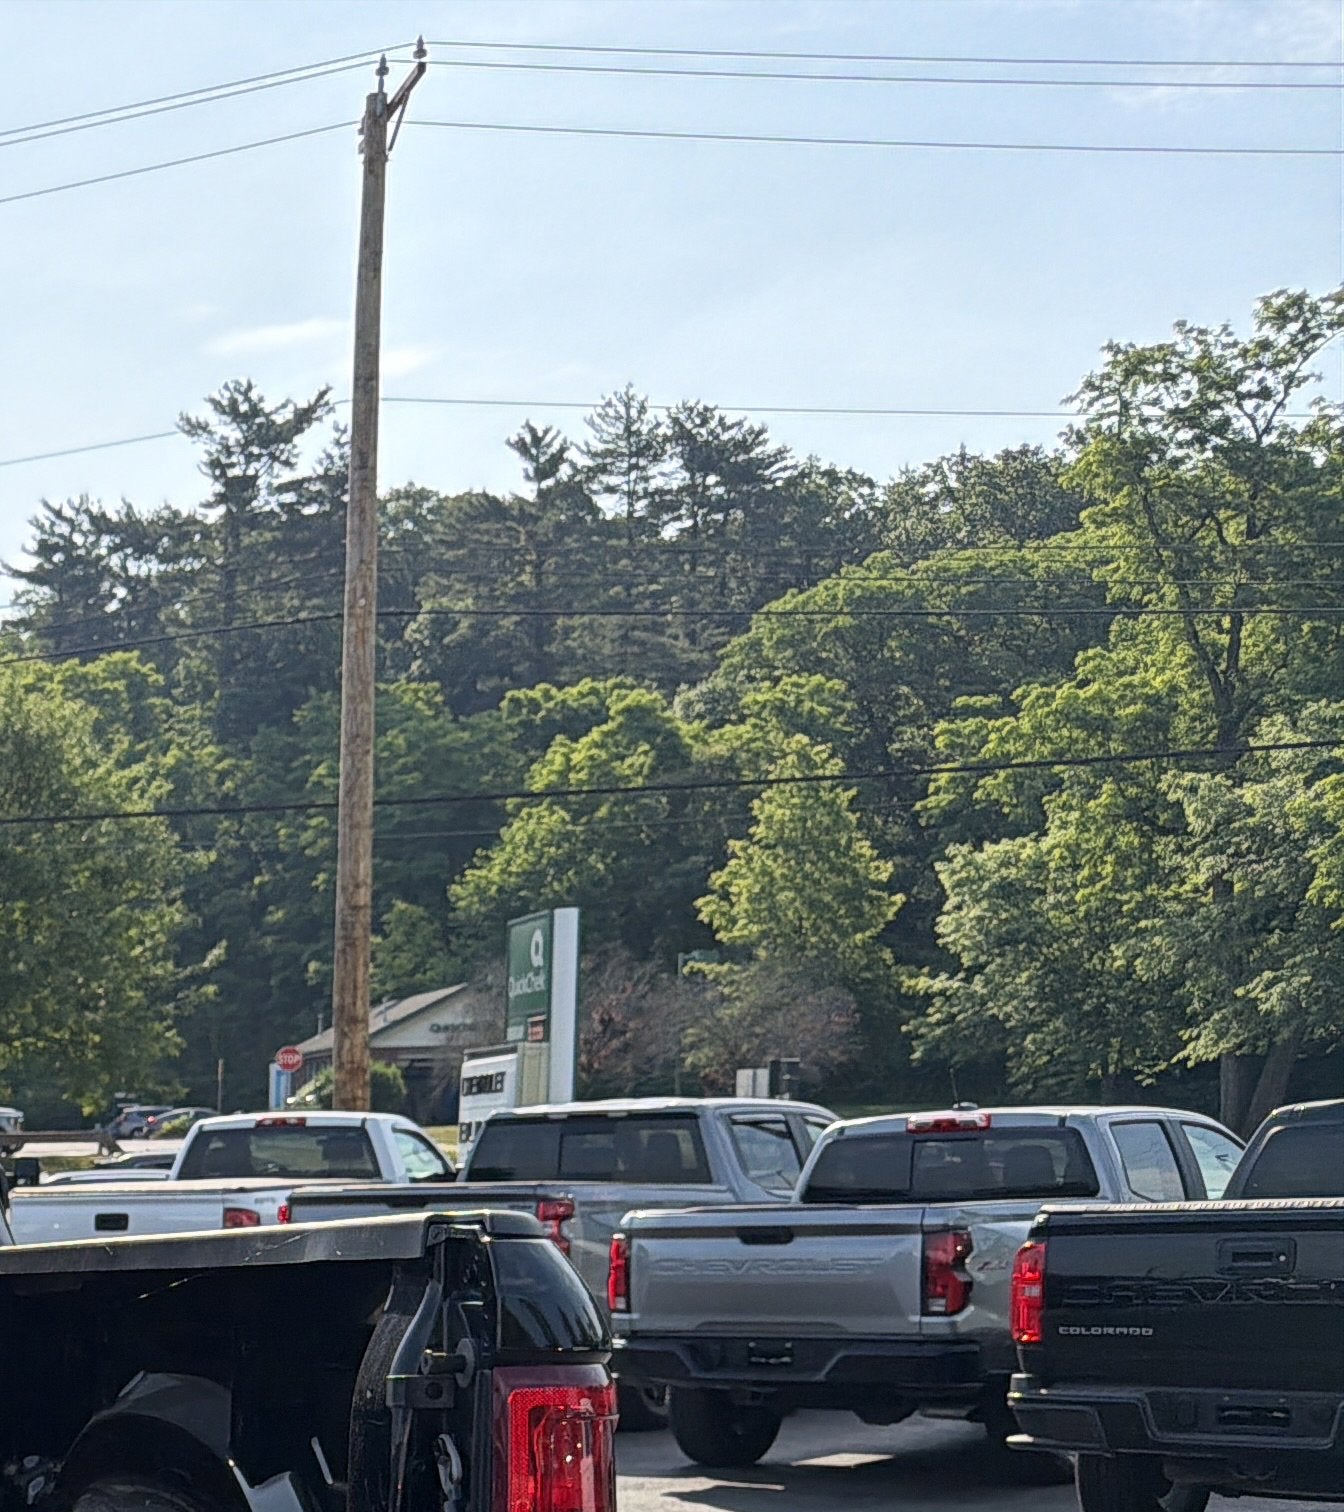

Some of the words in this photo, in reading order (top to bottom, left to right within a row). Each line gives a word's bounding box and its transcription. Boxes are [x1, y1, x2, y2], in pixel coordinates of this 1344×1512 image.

[276, 1053, 300, 1064] STOP
[1062, 1278, 1344, 1304] CHEVRO
[1058, 1326, 1153, 1336] COLORADO
